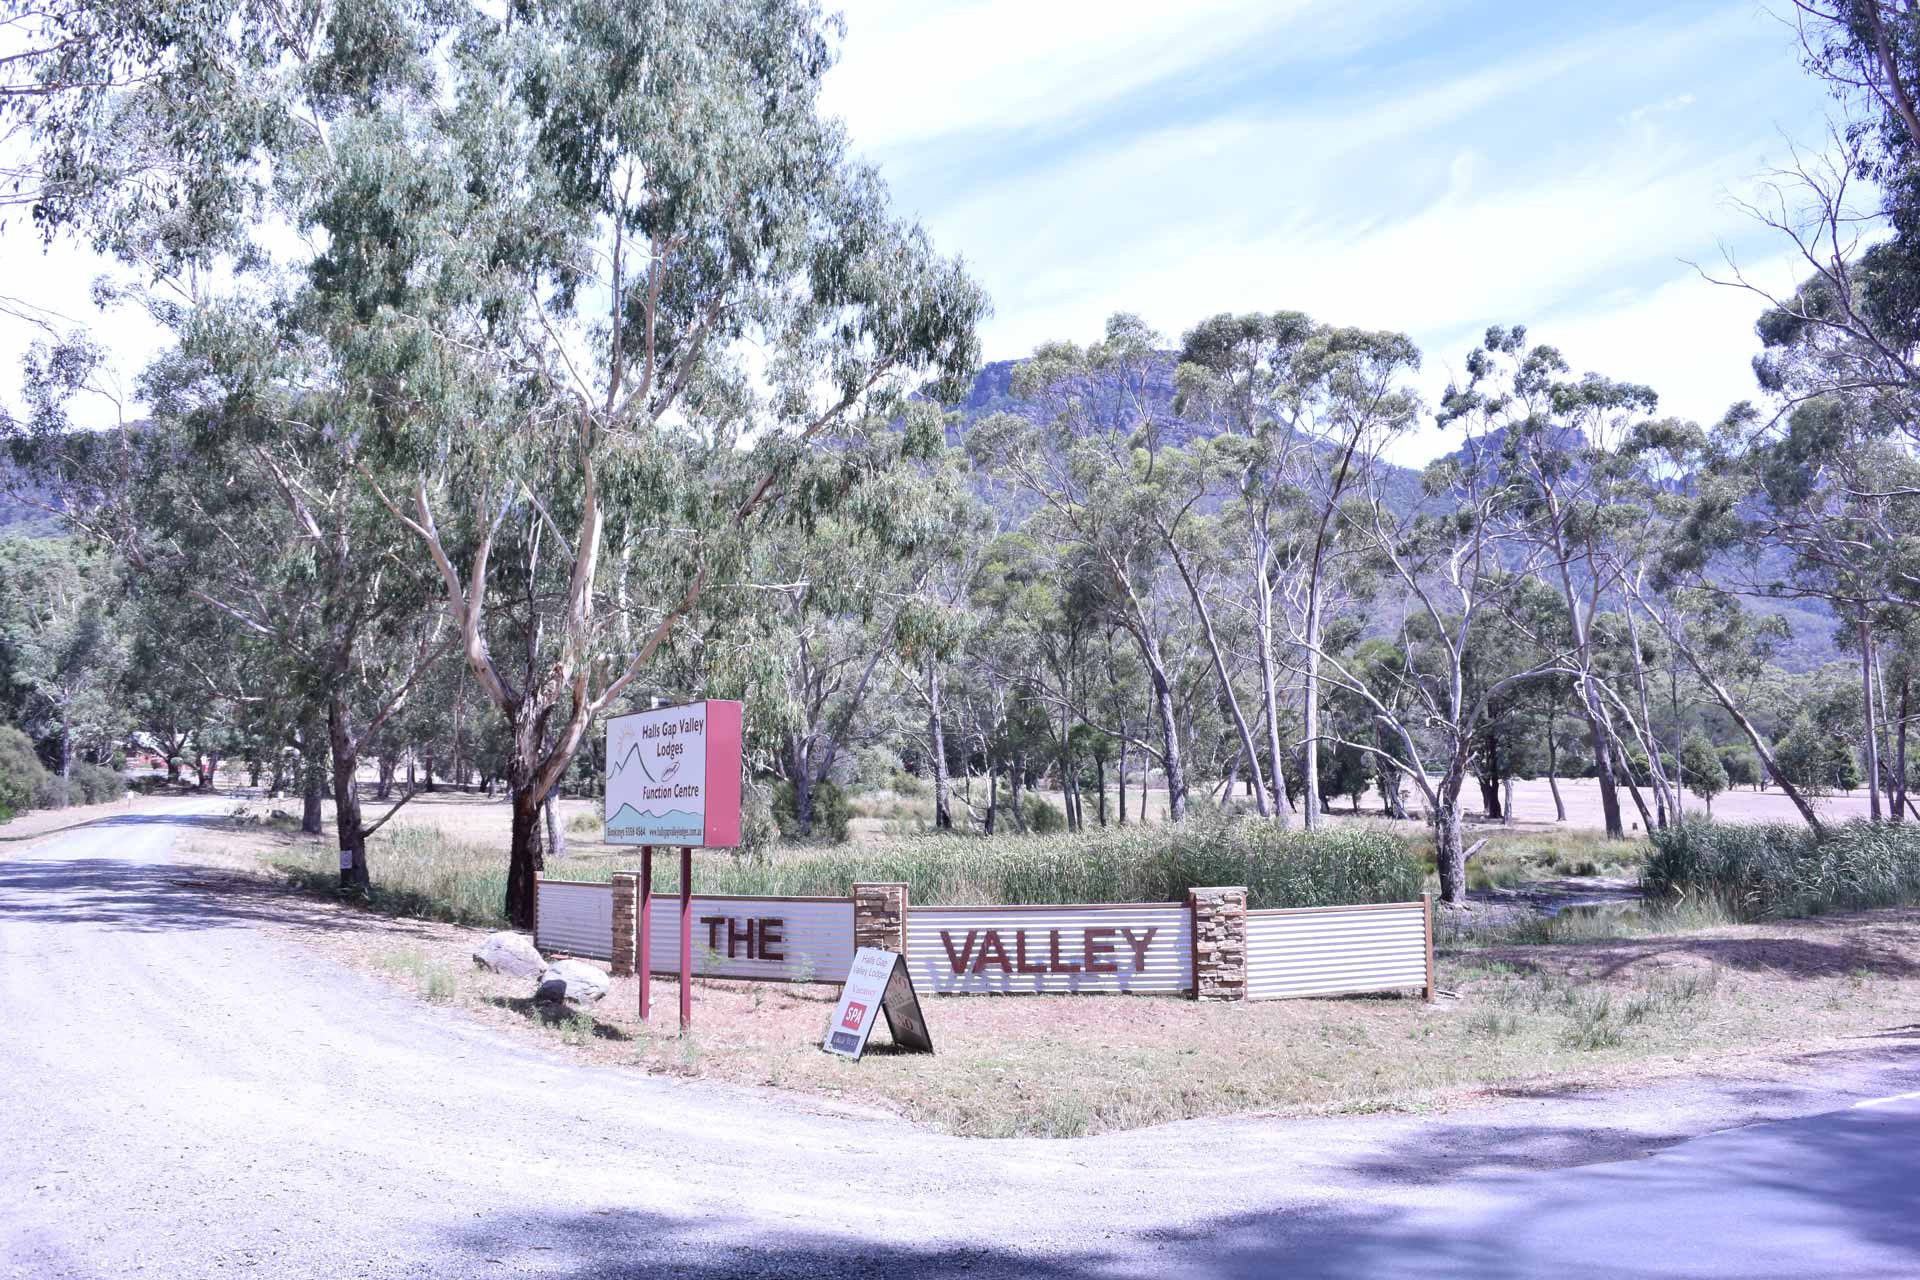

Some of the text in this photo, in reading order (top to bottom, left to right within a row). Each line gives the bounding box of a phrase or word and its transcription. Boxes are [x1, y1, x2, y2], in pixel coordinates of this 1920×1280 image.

[642, 718, 704, 739] Halls Gap Valley
[657, 742, 683, 759] Lodges
[643, 784, 699, 800] Function Centre
[701, 917, 1158, 973] THE VALLEY
[846, 1006, 863, 1025] SPA
